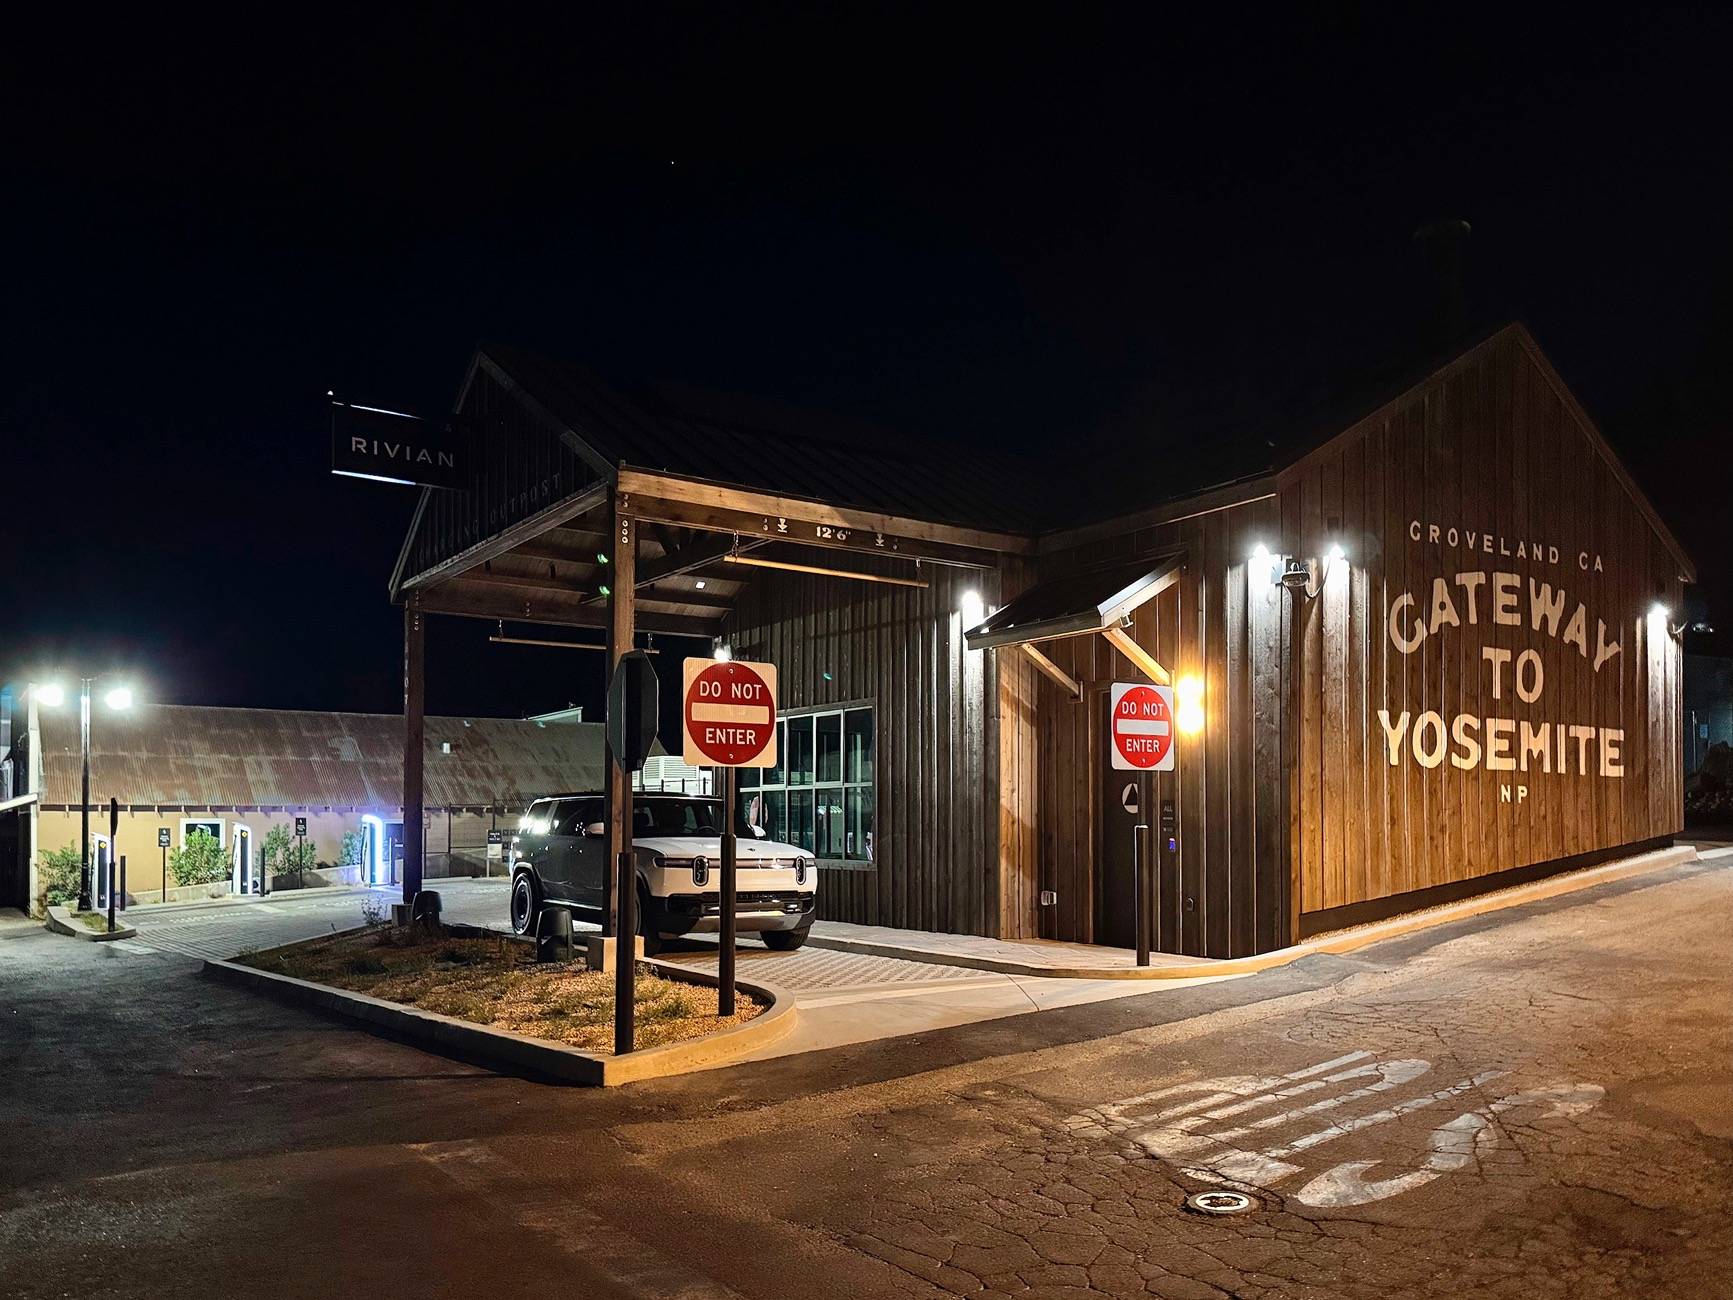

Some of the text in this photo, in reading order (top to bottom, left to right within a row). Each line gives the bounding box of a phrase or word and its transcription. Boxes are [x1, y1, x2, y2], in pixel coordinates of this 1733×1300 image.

[351, 436, 454, 468] RIVIAN
[489, 472, 561, 525] OUTPOST
[1409, 520, 1604, 572] GROVELAND CA
[1389, 571, 1622, 673] GATEWAY
[700, 680, 762, 700] DO NOT
[1482, 646, 1544, 704] TO
[1121, 701, 1164, 717] DO NOT
[705, 727, 756, 745] ENTER
[1126, 738, 1160, 753] ENTER
[1377, 709, 1625, 778] YOSEMITE
[1500, 783, 1528, 804] NP
